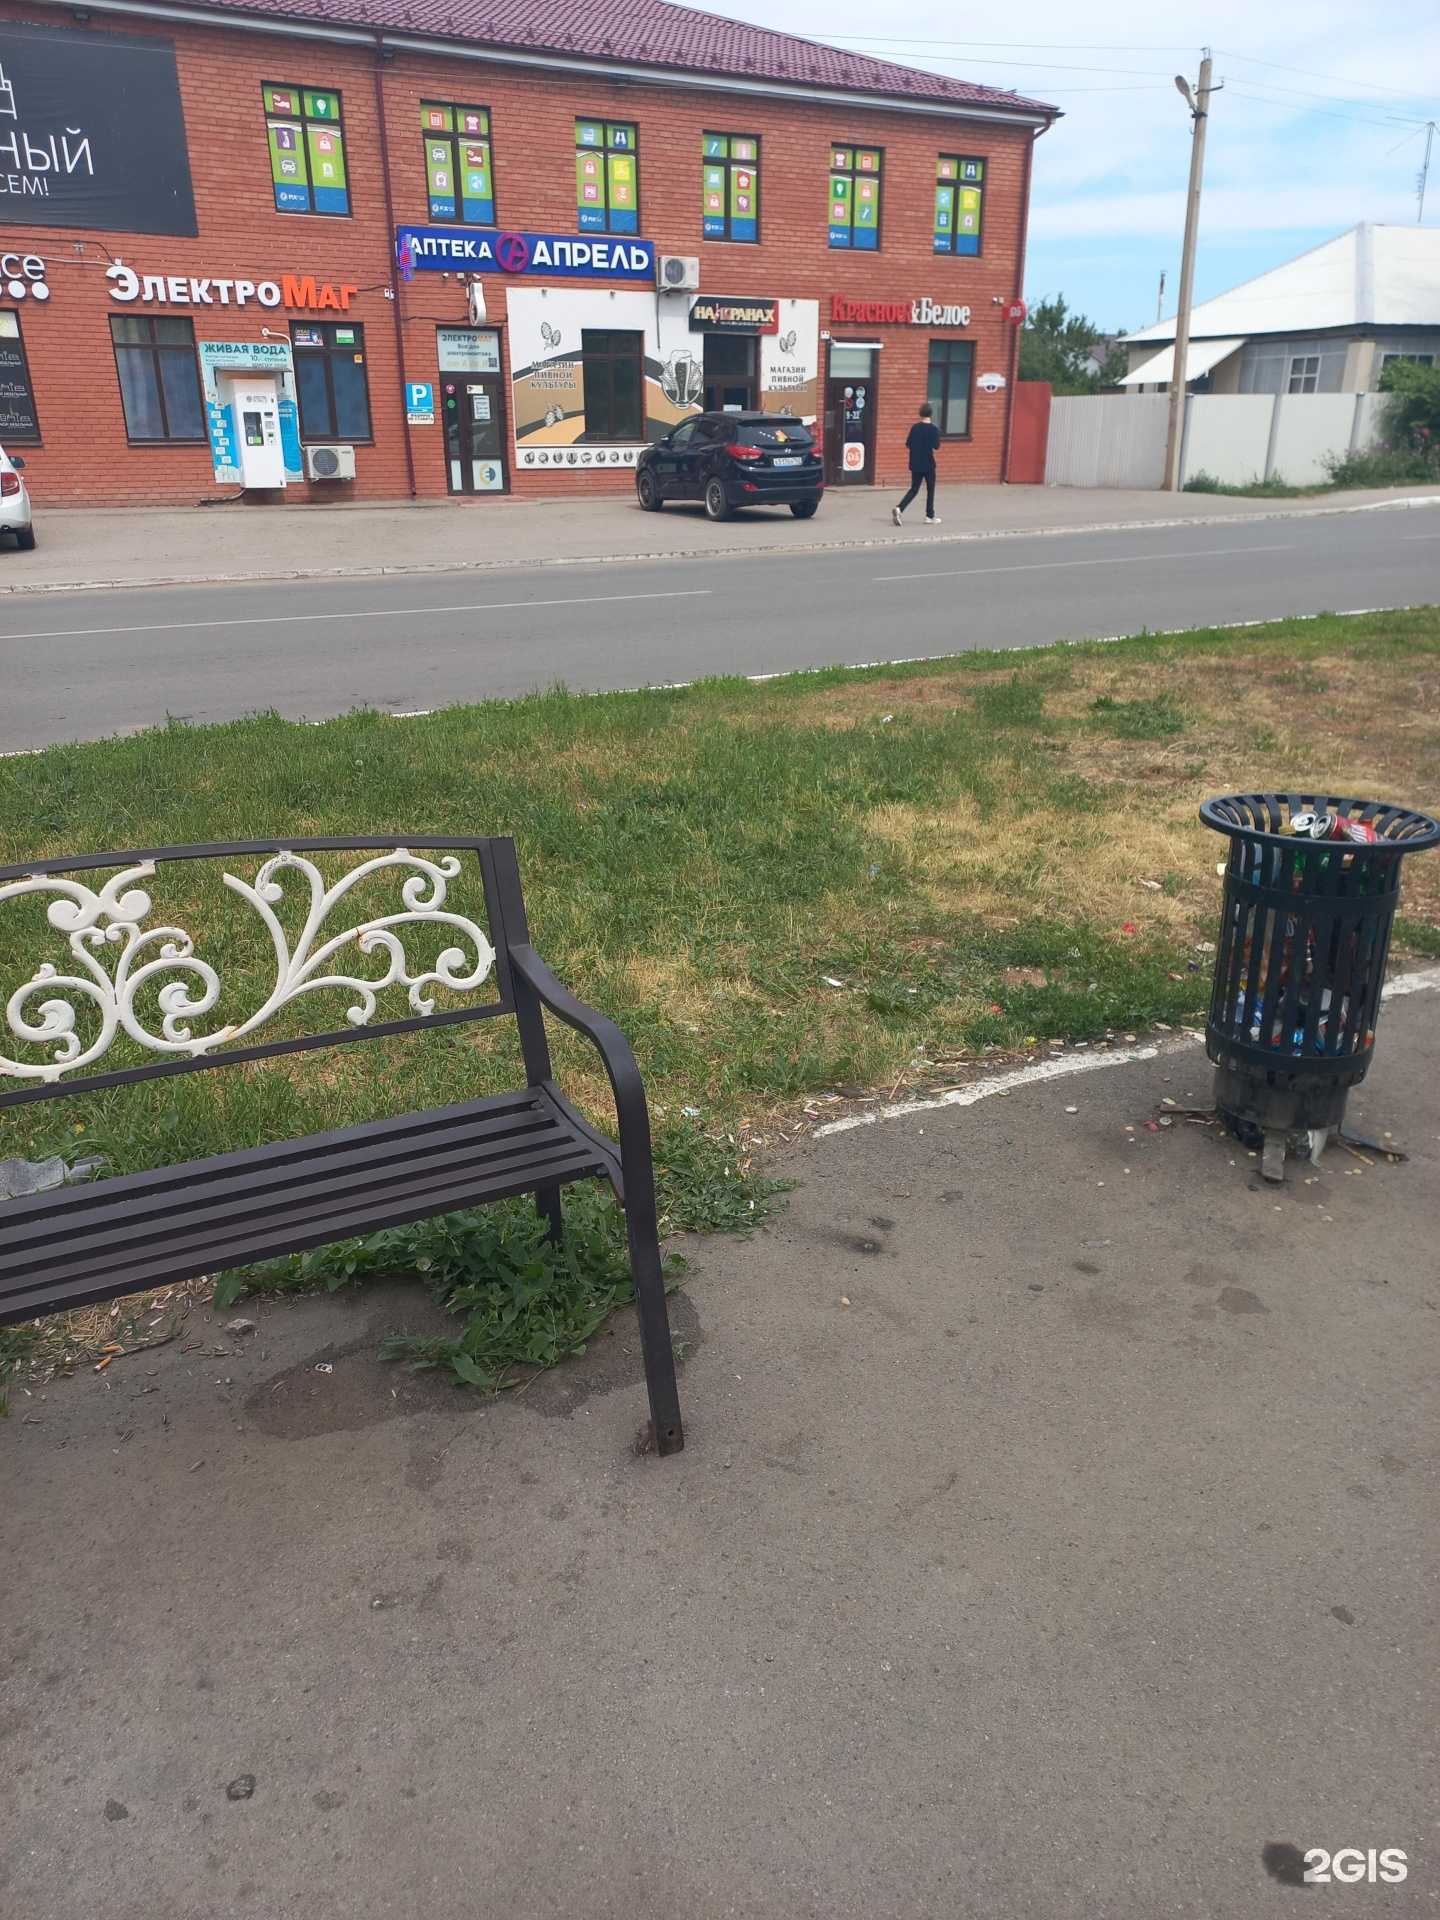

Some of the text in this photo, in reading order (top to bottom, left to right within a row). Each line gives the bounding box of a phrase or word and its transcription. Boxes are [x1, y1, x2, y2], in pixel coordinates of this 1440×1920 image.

[410, 237, 650, 271] АПТЕКА АПРЕЛЬ
[204, 343, 287, 355] ЖИВАЯ ВОДА
[770, 366, 806, 374] МАГАЗИН
[771, 375, 804, 384] ПИВНОЙ
